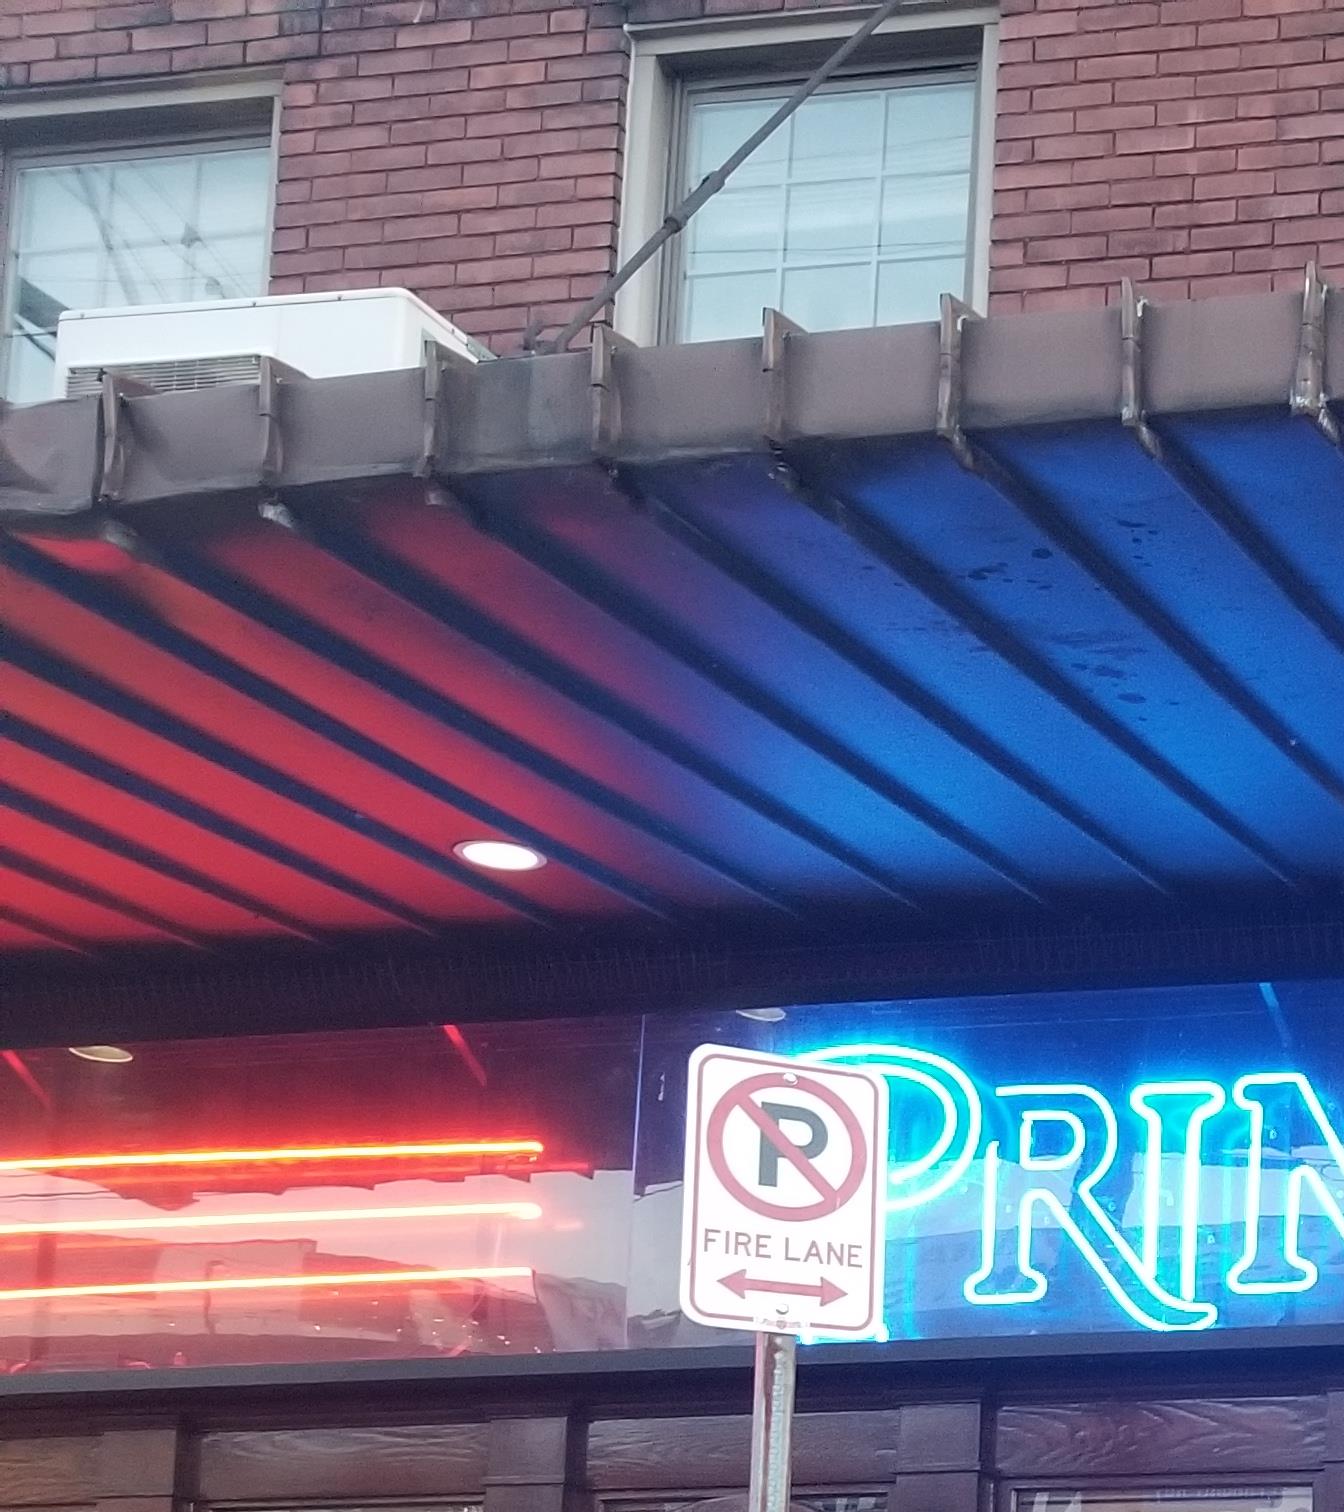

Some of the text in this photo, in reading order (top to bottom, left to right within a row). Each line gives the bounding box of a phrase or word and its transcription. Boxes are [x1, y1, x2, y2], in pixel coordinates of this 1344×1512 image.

[757, 1101, 829, 1188] P
[704, 1228, 863, 1269] FIRE LANE
